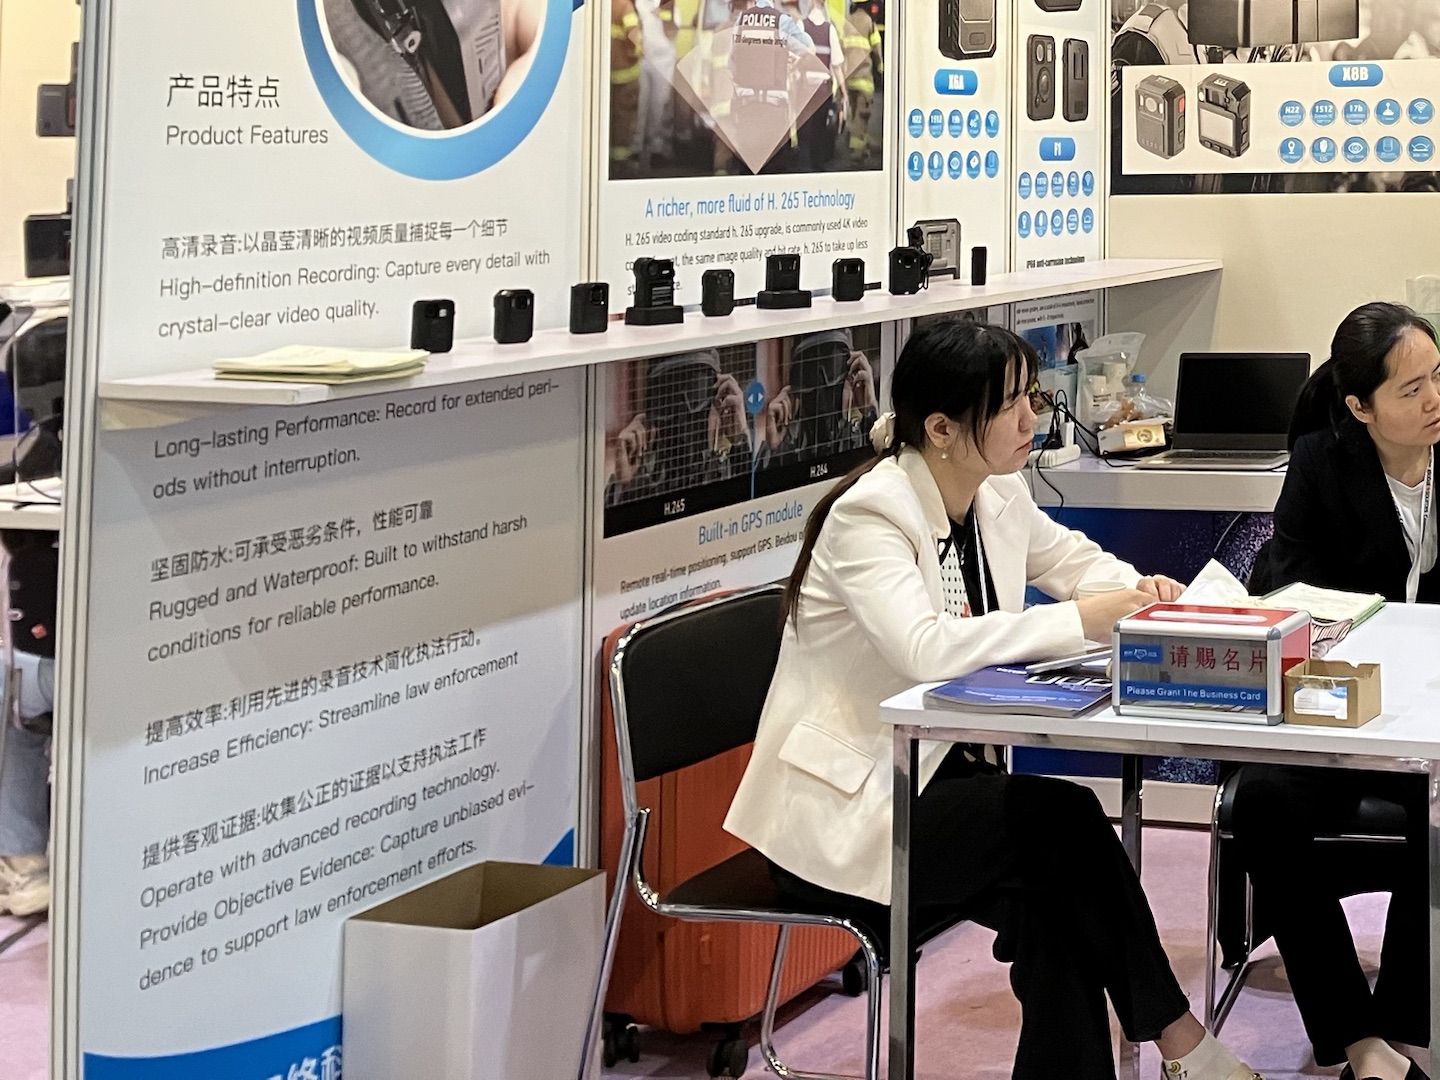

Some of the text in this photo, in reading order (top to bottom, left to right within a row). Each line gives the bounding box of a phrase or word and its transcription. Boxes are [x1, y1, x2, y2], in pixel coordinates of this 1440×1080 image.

[742, 12, 776, 28] POLICE
[166, 73, 280, 110] 产品特点
[166, 123, 329, 146] Product Features
[645, 189, 855, 218] A richer, more fluid of H. 265 Technology
[159, 249, 550, 301] High-definition Recording: Capture every detail with
[157, 299, 380, 340] crystal-clear video quality.
[153, 378, 560, 460] Long-lasting Performance: Record for extended peri-
[152, 446, 360, 501] ods without interruption.
[698, 501, 803, 545] Built-in GPS module
[148, 514, 528, 624] Rugged and Waterproof: Built to withstand harsh
[620, 577, 650, 594] Remote
[147, 573, 439, 662] conditions for reliable performance.
[620, 600, 646, 620] update
[1170, 645, 1267, 673] 请赐名片
[1126, 686, 1155, 695] Please
[1200, 690, 1238, 699] Business
[1240, 692, 1261, 700] Card
[143, 650, 519, 786] Increase Efficiency: Streamline law enforcement
[139, 760, 500, 910] Operate with advanced recording technology.
[139, 783, 535, 950] Provide Objective Evidence: Capture unbiased evi-
[138, 838, 477, 992] dence to support law enforcement efforts.
